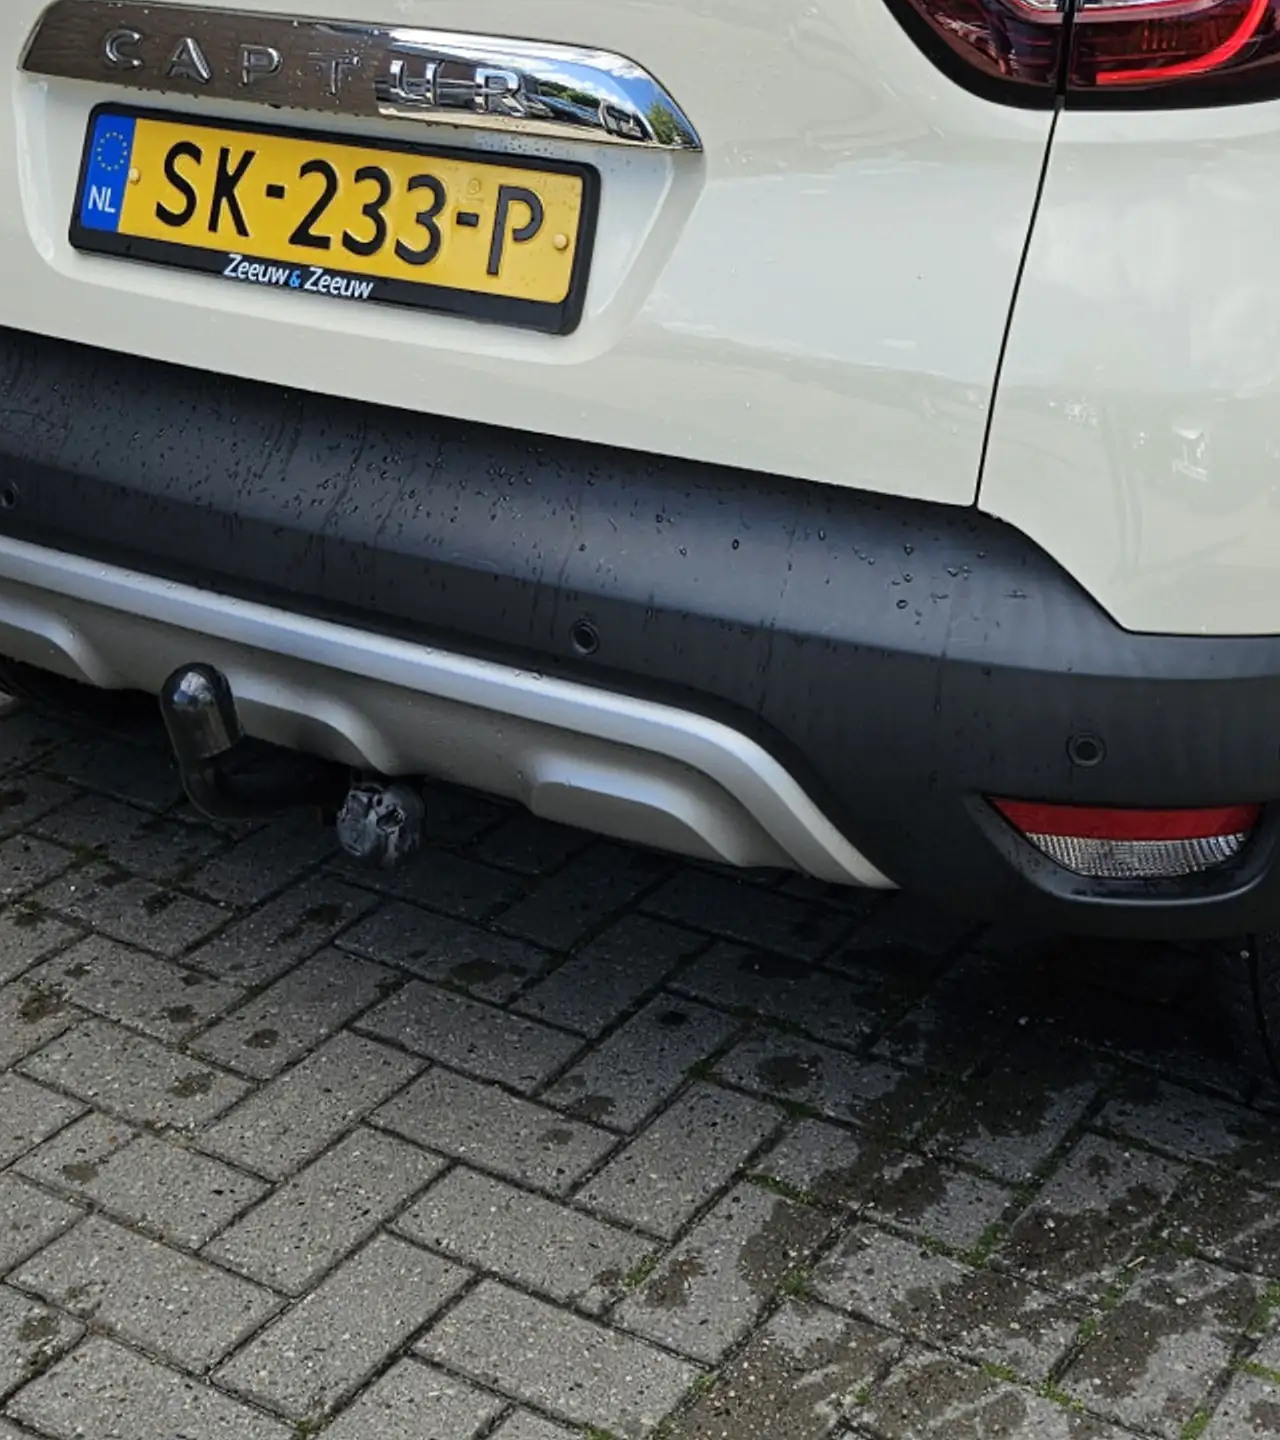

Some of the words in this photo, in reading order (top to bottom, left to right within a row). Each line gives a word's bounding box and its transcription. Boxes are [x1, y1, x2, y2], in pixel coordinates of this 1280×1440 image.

[104, 28, 529, 118] CAPTUR
[87, 184, 116, 214] NL
[154, 140, 544, 276] SK-233-P
[223, 253, 289, 285] Zeeuw
[304, 266, 374, 299] Zeeuw
